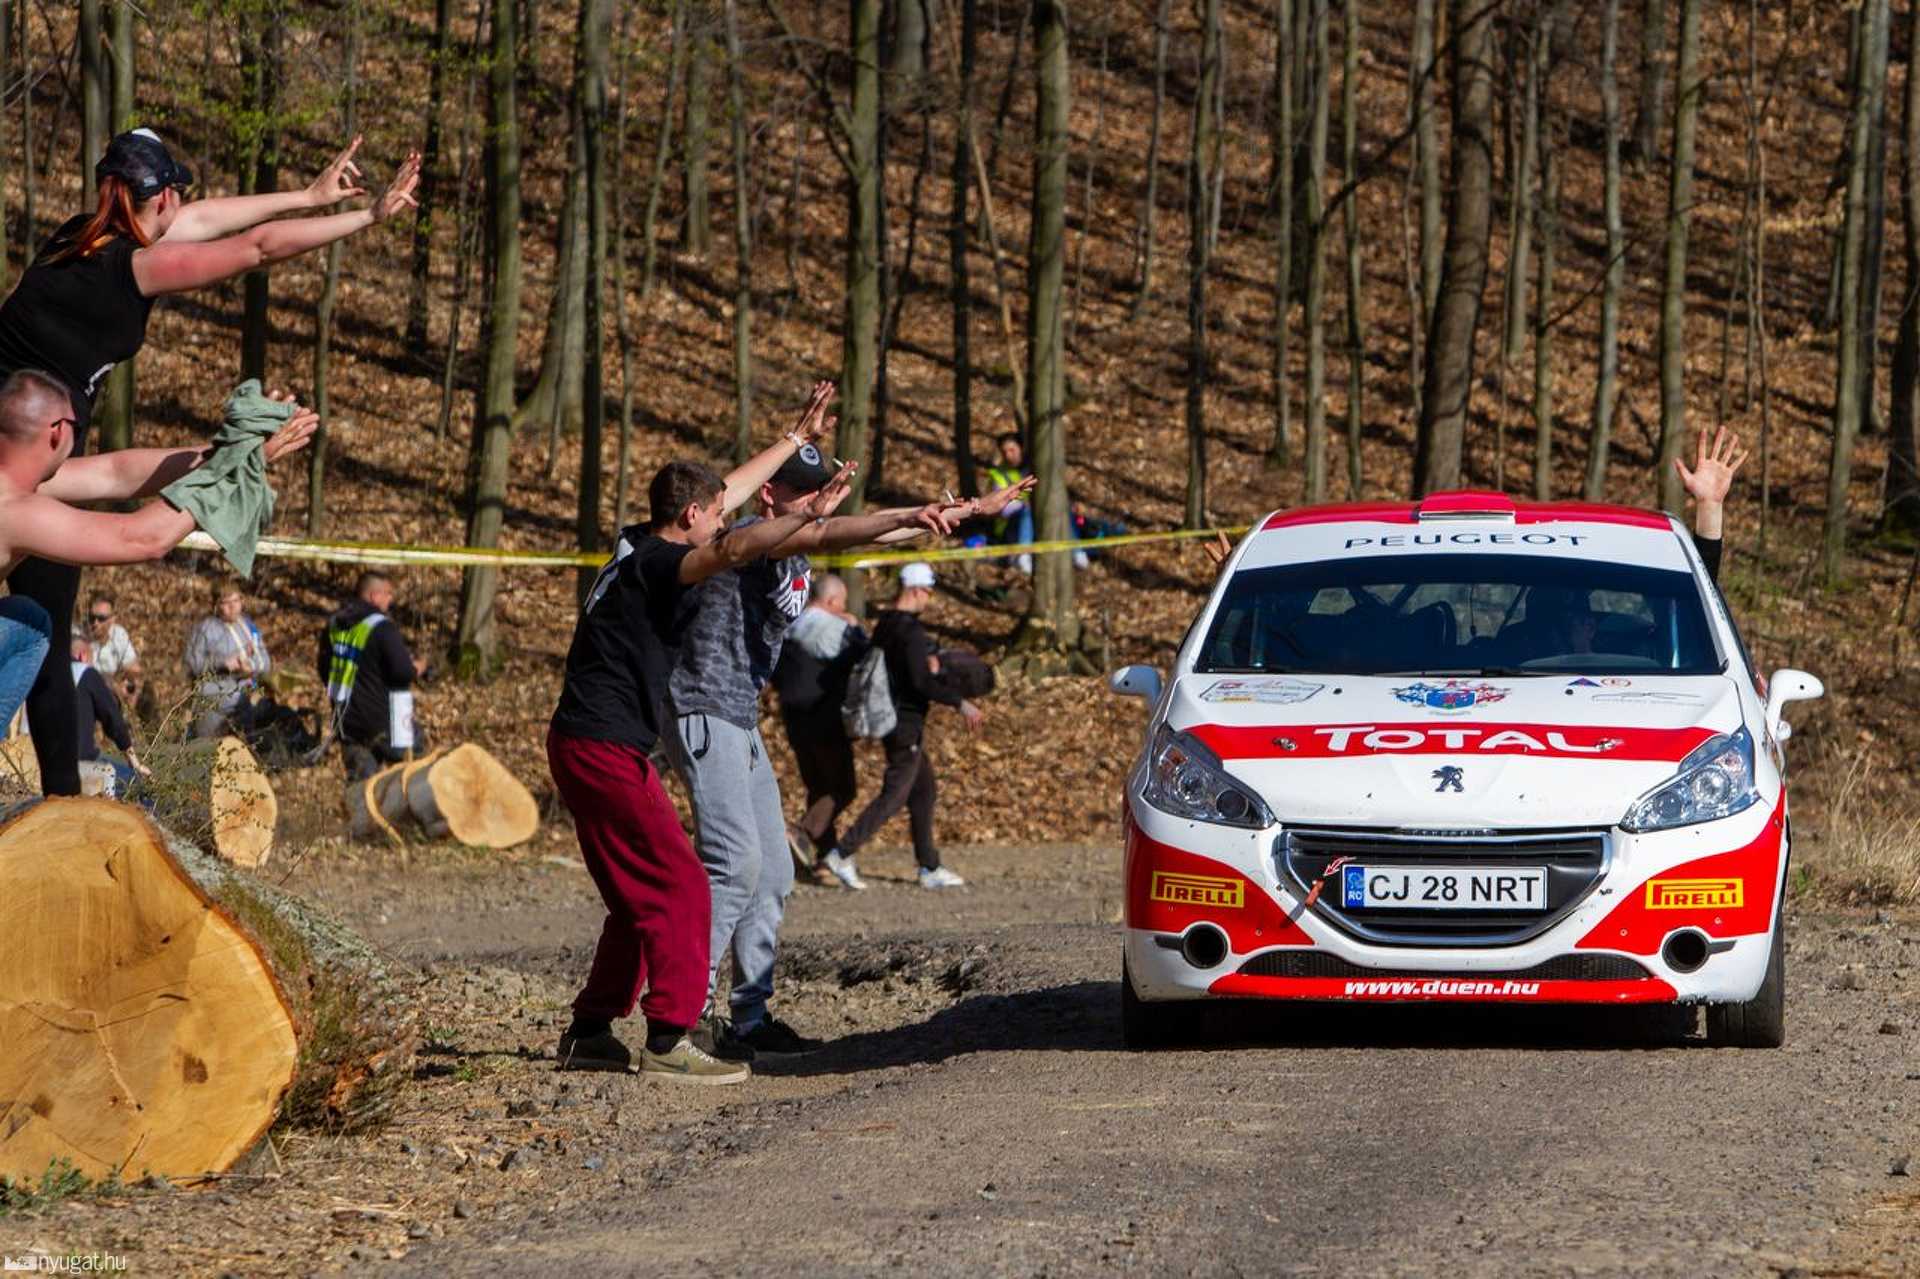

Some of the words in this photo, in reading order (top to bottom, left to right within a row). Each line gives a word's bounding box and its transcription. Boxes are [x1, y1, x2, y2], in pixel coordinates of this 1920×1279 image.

[1345, 533, 1588, 549] PEUGEOT
[1314, 726, 1606, 752] TOTAL
[1156, 875, 1237, 904] PIRELLI
[1369, 875, 1410, 901] CJ
[1422, 876, 1458, 901] 28
[1471, 876, 1540, 902] NRT
[1652, 883, 1736, 905] PIRELLI
[1344, 980, 1541, 995] www.duen.hu
